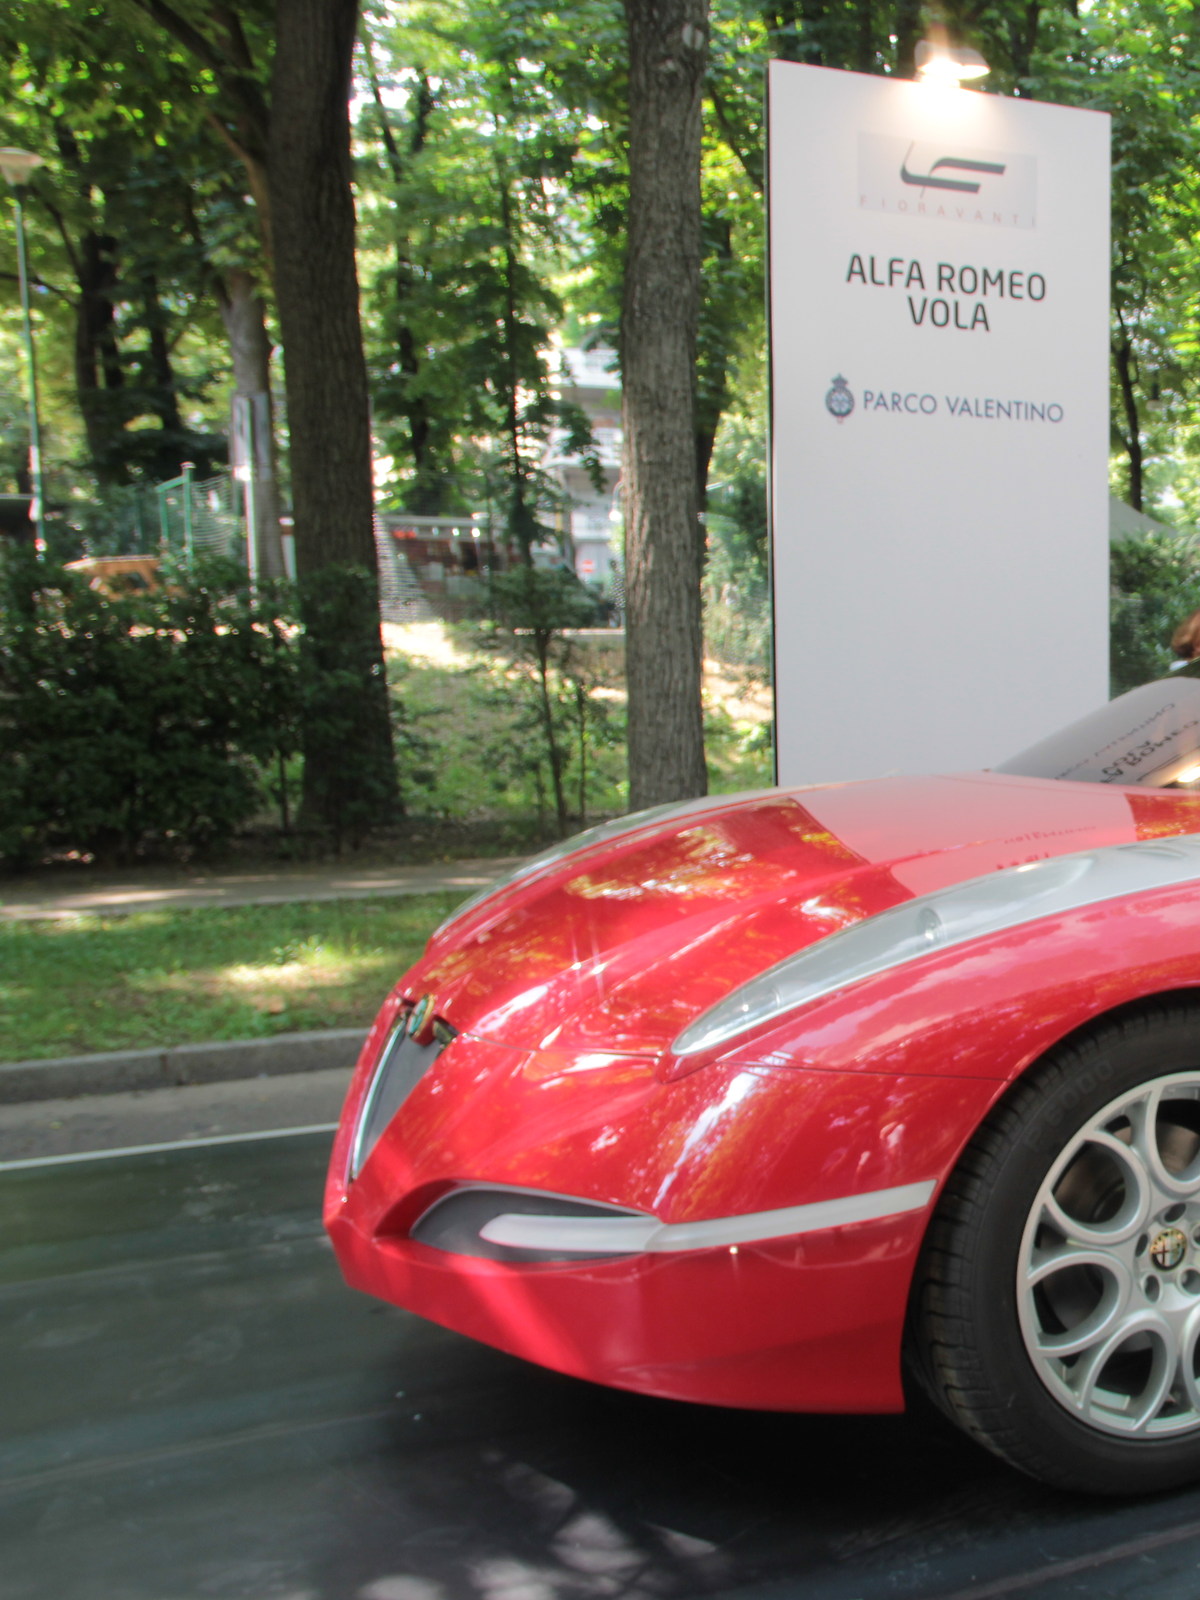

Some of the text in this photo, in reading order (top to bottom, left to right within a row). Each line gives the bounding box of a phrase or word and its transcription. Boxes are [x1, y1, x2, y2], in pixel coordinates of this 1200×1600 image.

[859, 195, 1036, 228] FIORAVANTI
[846, 253, 1046, 302] ALFA ROMEO
[907, 296, 990, 332] VOLA
[863, 390, 1065, 423] PARCO VALENTINO
